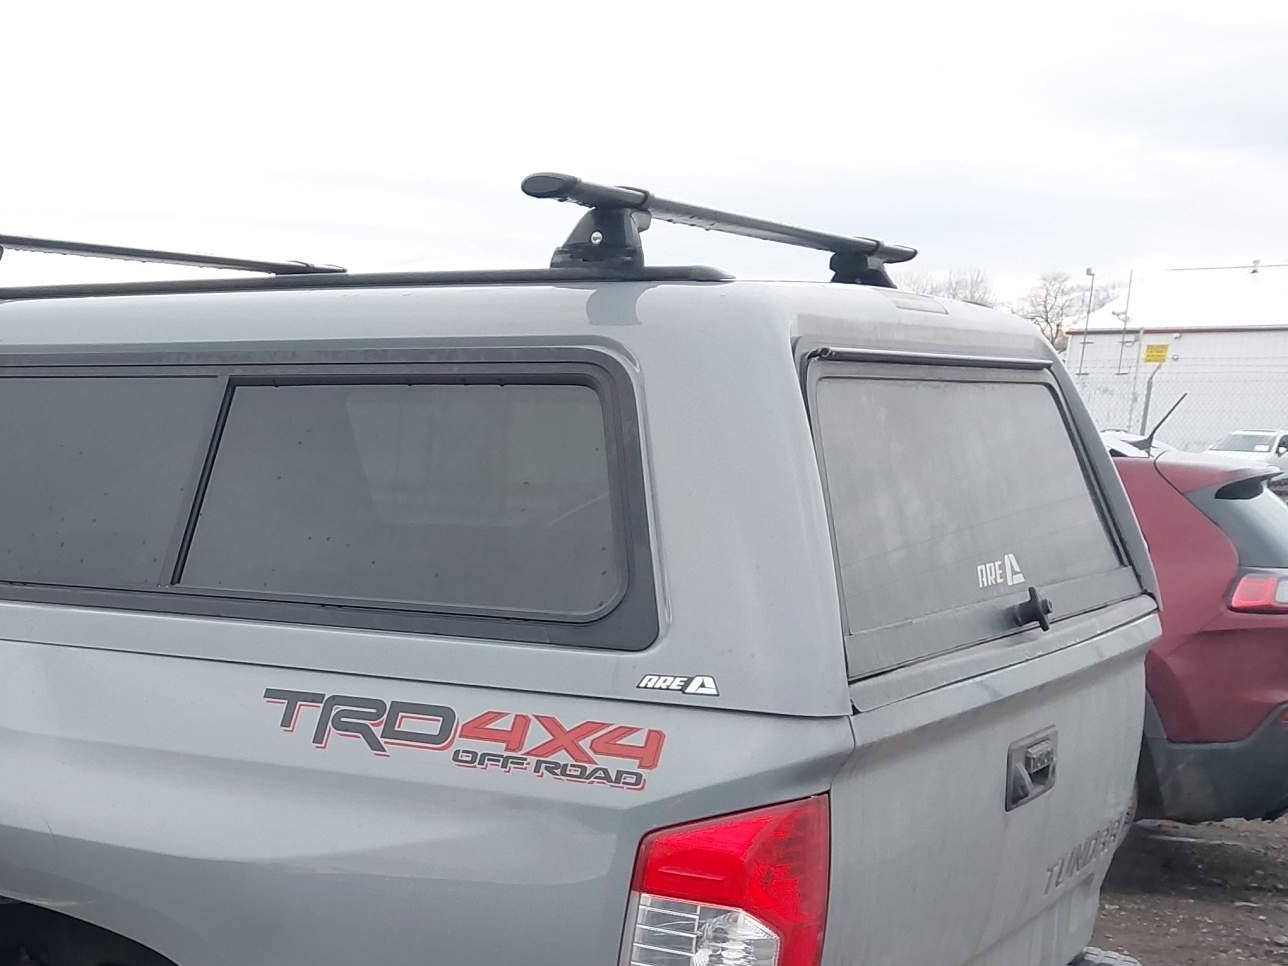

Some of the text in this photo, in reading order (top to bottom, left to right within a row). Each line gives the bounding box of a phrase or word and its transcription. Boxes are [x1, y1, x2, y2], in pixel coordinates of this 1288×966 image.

[263, 687, 460, 758] TRD
[452, 749, 647, 791] OFF ROAD
